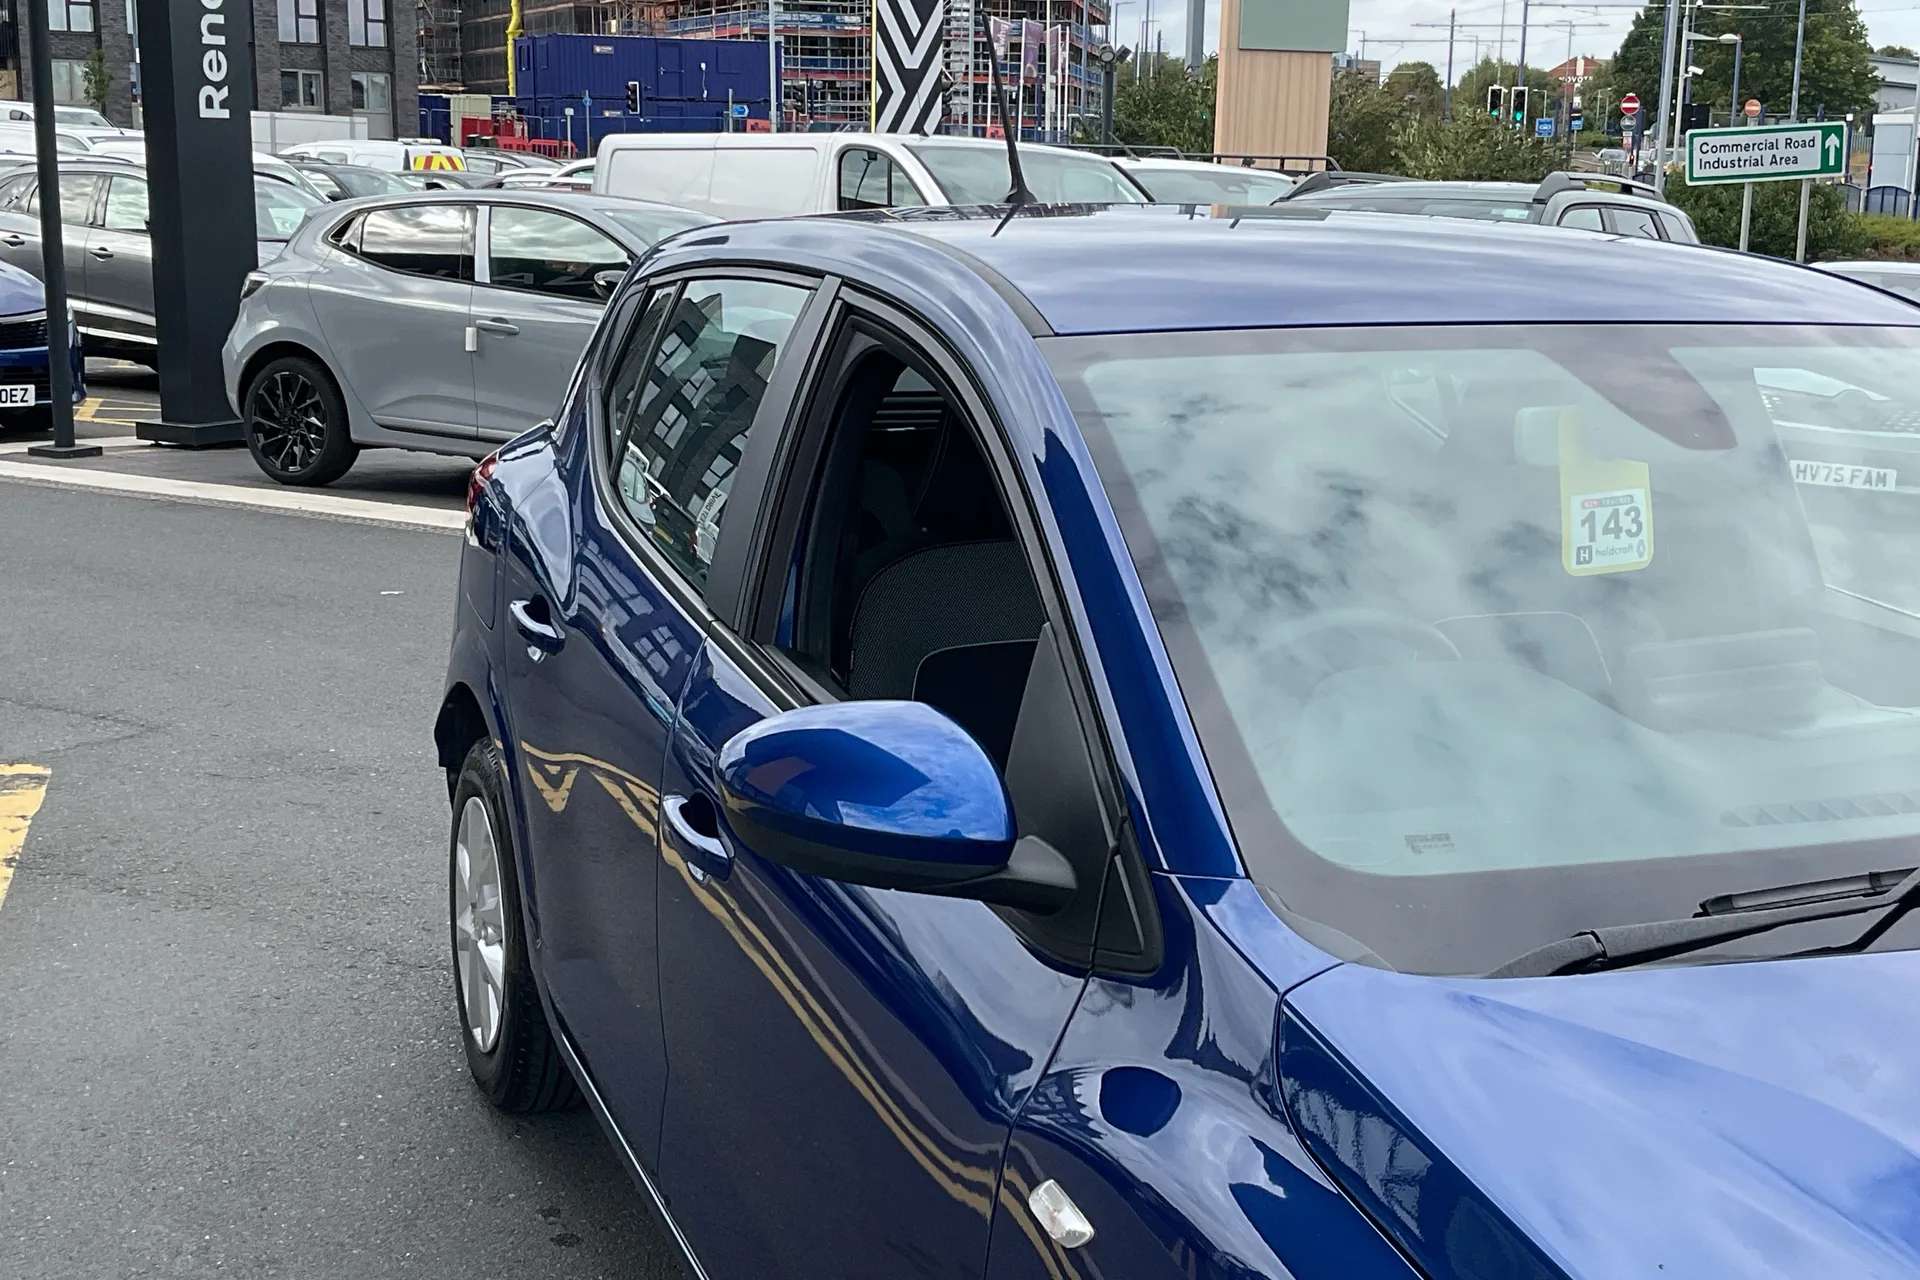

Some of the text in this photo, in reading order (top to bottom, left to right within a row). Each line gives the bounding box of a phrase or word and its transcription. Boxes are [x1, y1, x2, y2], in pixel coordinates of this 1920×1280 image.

[1699, 136, 1816, 154] Commercial Road
[1699, 153, 1799, 170] Industrial Area
[1796, 463, 1888, 488] HV75 FAM
[1581, 505, 1643, 543] 143
